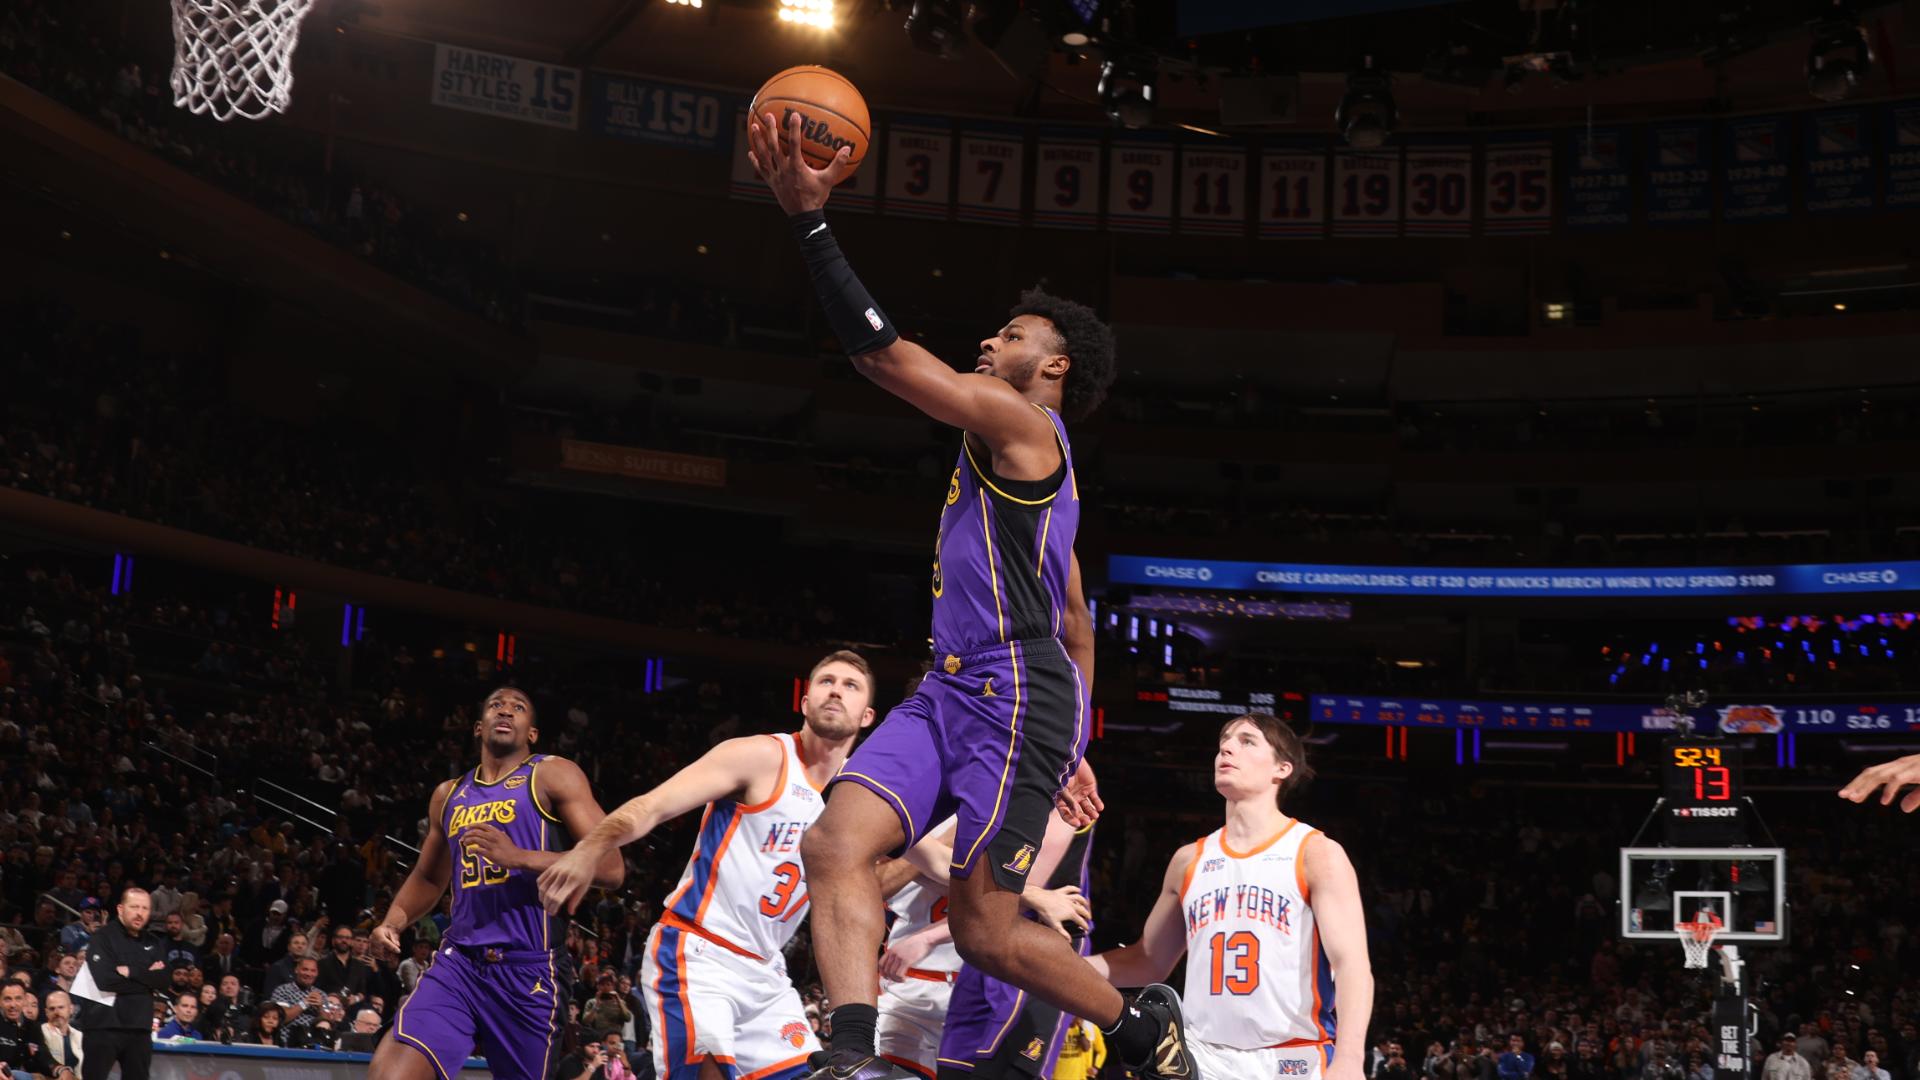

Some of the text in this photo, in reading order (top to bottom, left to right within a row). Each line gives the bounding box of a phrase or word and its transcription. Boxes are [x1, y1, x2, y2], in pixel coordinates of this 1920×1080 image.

[447, 50, 516, 80] HARRY
[440, 71, 521, 102] STYLES
[530, 66, 575, 111] 15
[608, 83, 646, 105] BILLY
[608, 104, 640, 127] JOEL
[648, 88, 720, 139] 150
[905, 154, 930, 195] 3
[976, 159, 1004, 203] 7
[1054, 165, 1080, 207] 9
[1127, 169, 1153, 211] 9
[1193, 172, 1232, 215] 11
[1272, 176, 1311, 218] 11
[1342, 173, 1390, 216] 19
[1411, 173, 1466, 216] 30
[1489, 169, 1546, 214] 35
[623, 455, 667, 475] SUITE
[672, 461, 720, 481] LEVEL
[1145, 565, 1196, 580] CHASE
[1256, 570, 1302, 584] CHASE
[1303, 571, 1409, 587] CARDHOLDERS:
[1411, 575, 1437, 588] GET
[1467, 575, 1494, 589] OFF
[1496, 576, 1549, 589] KNICKS
[1552, 576, 1603, 589] MERCH
[1604, 576, 1652, 589] WHEN
[1654, 575, 1686, 589] YOU
[1688, 575, 1736, 589] SPEND
[1822, 570, 1880, 585] CHASE
[1796, 709, 1836, 725] 110
[1847, 715, 1891, 729] 52.6
[1673, 747, 1721, 767] 52.4
[1694, 767, 1730, 800] 13
[448, 799, 517, 838] LAKERS
[1690, 807, 1738, 817] TISSOT
[760, 822, 807, 853] NE
[1188, 885, 1291, 939] NEW YORK
[1210, 931, 1260, 996] 13
[1721, 1025, 1739, 1040] GET
[1721, 1040, 1740, 1054] THE
